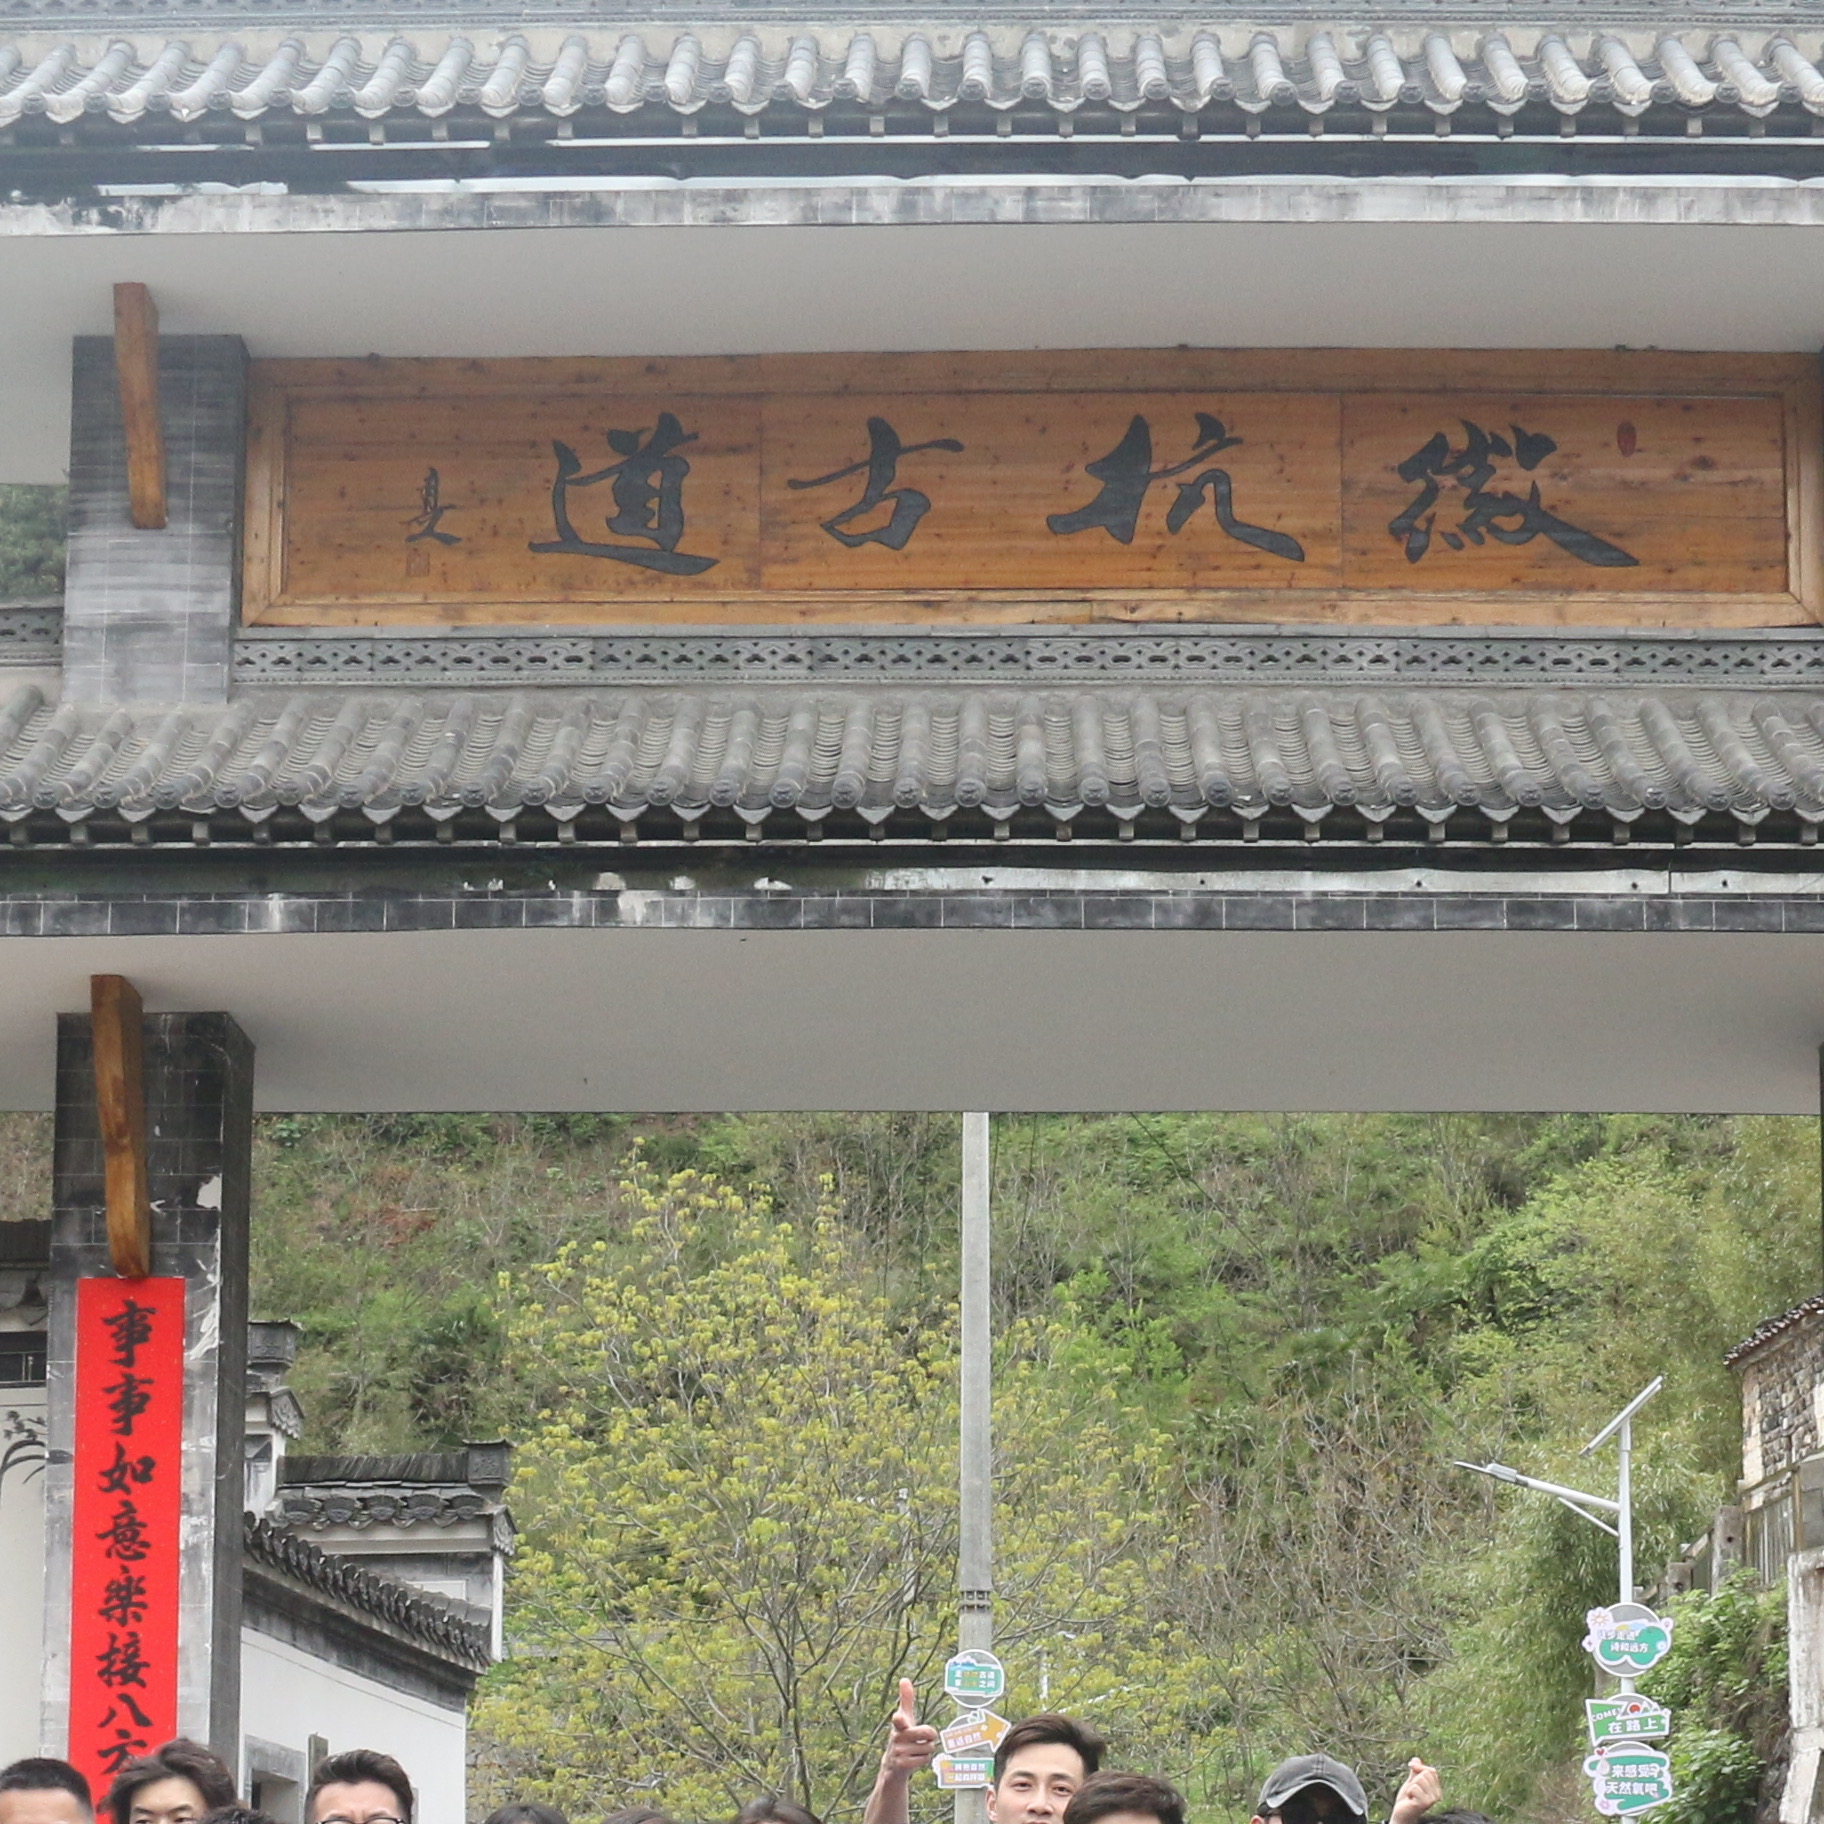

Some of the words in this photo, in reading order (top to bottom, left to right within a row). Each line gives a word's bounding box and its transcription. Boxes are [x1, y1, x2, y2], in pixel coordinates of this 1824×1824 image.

[529, 411, 1640, 577] 徽杭古道
[1608, 1717, 1658, 1734] 在路上
